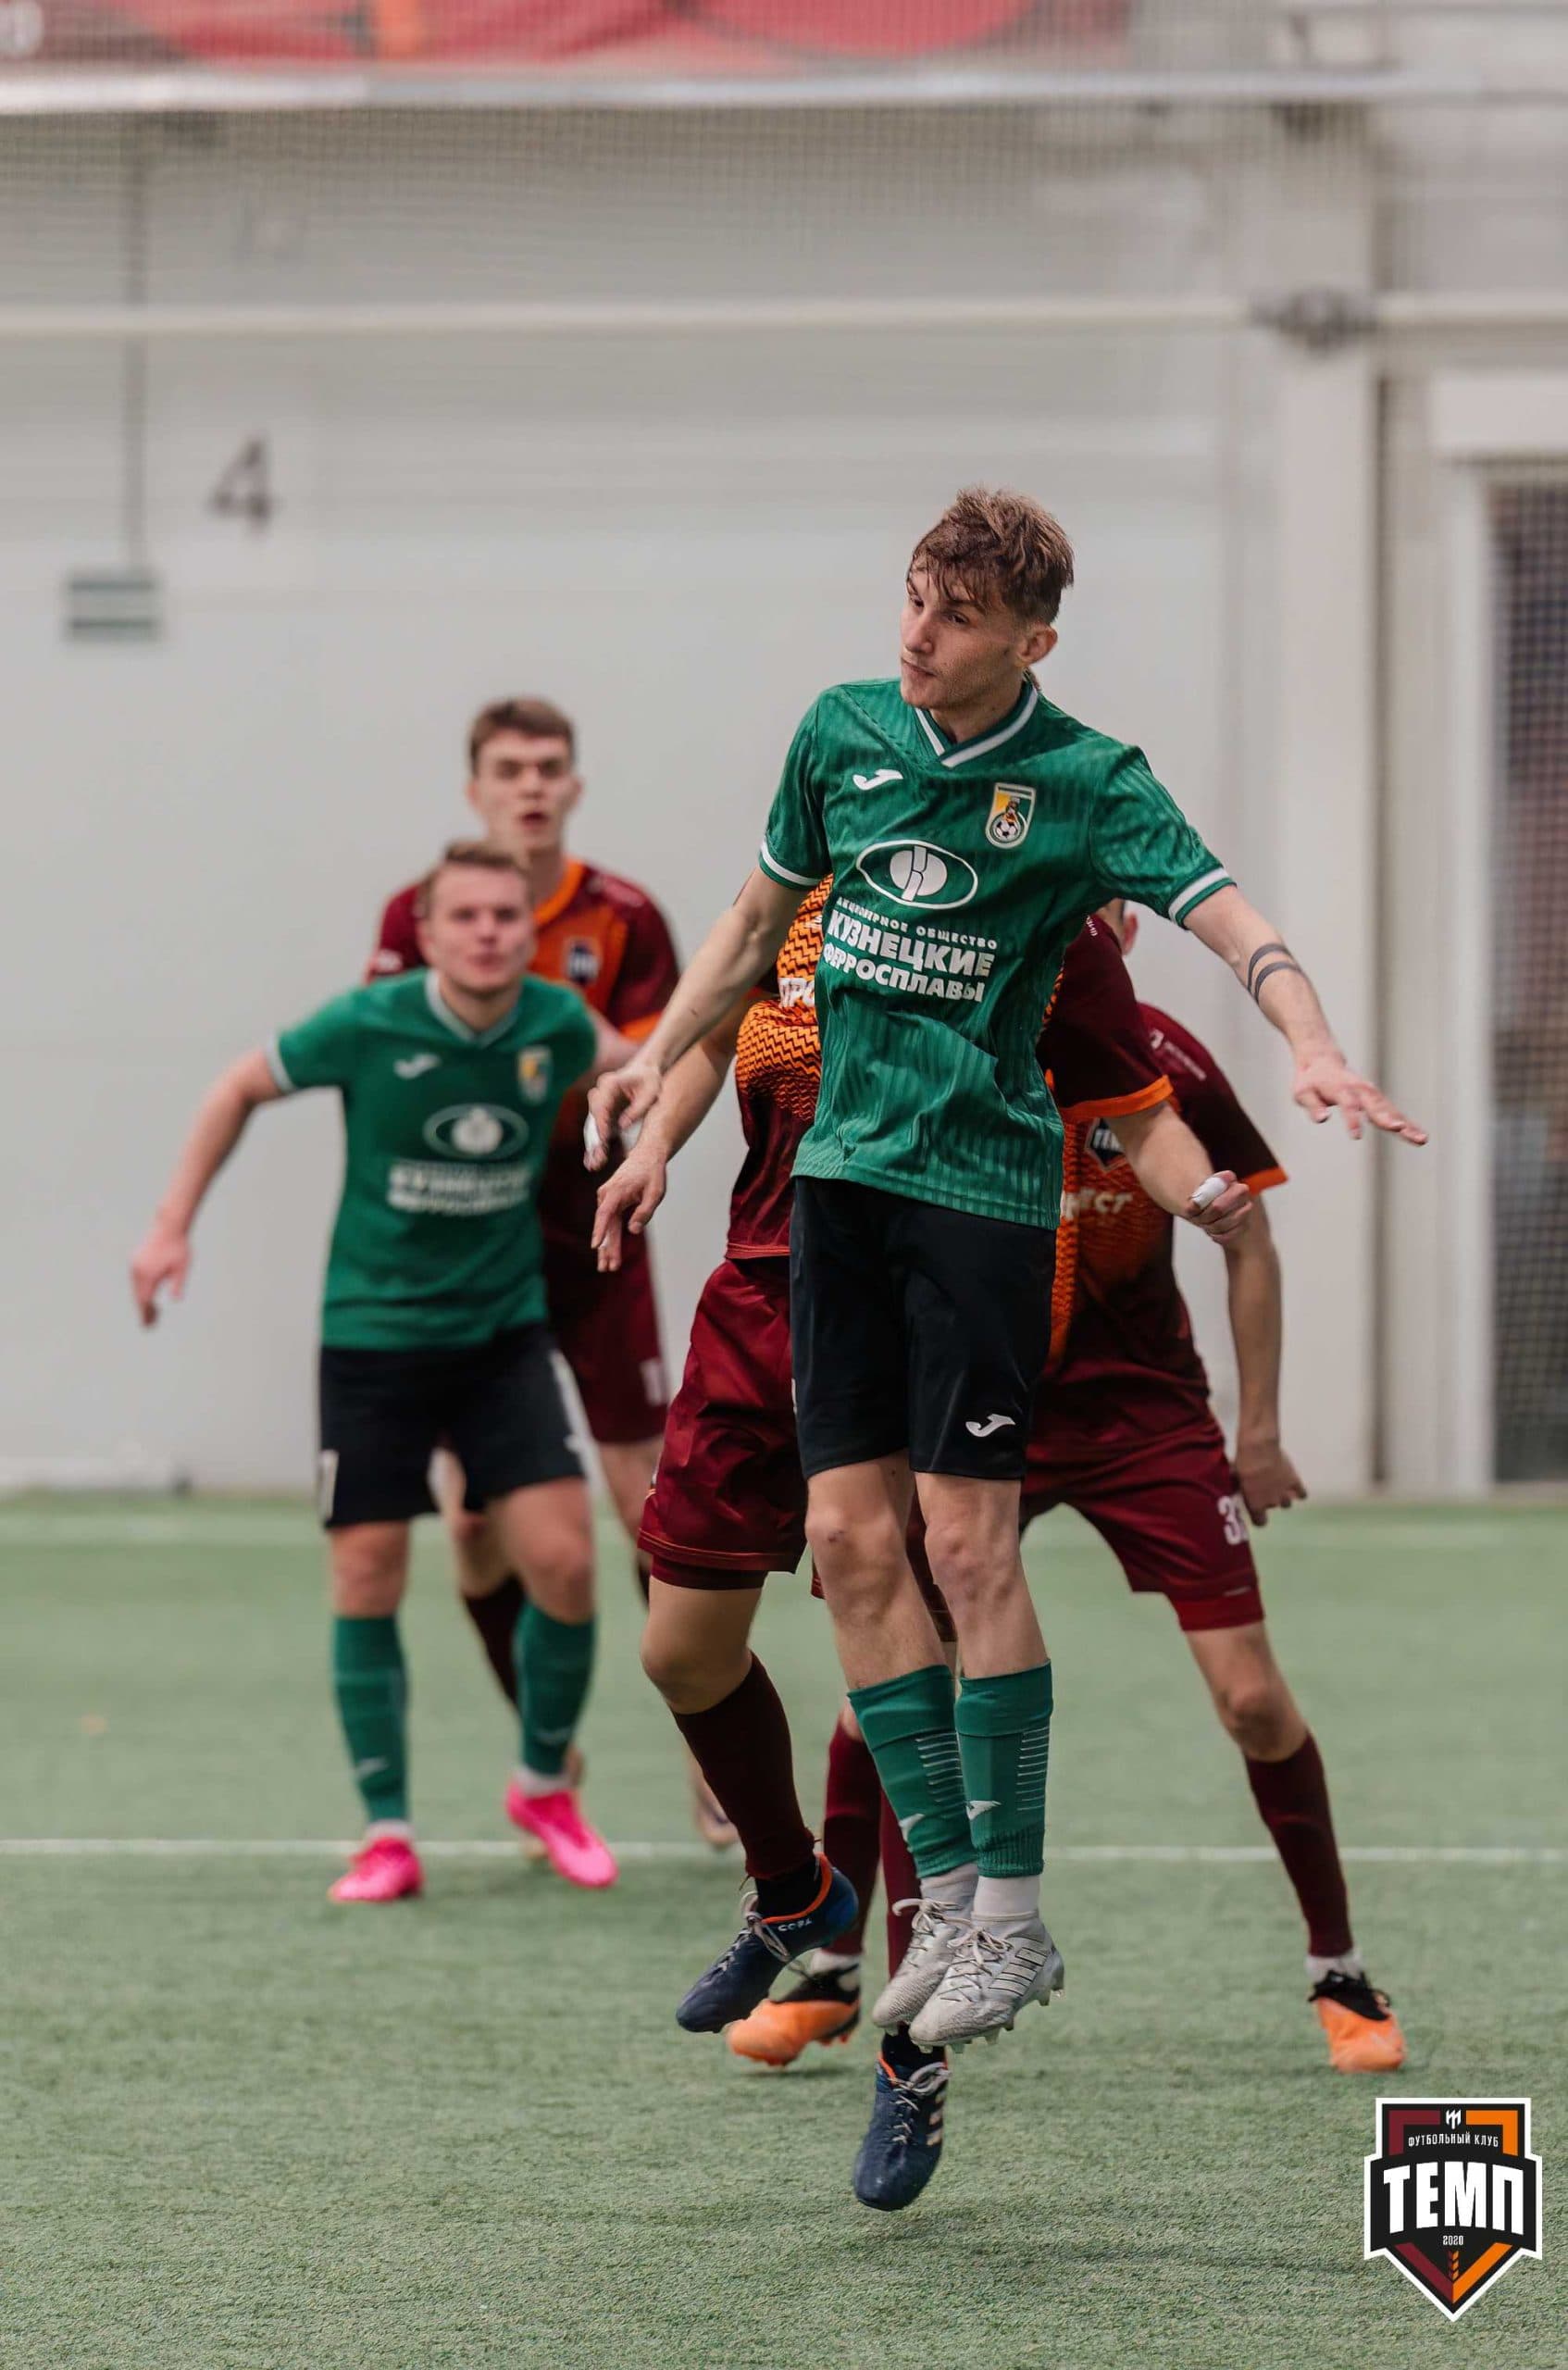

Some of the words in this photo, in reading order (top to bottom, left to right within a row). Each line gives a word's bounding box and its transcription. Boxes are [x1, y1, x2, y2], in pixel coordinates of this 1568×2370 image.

[827, 910, 995, 978] КУЗНЕЦКИЕ
[915, 926, 997, 950] ОБЩЕСТВО
[823, 942, 986, 1003] ФЕРРОСПЛАВЫ
